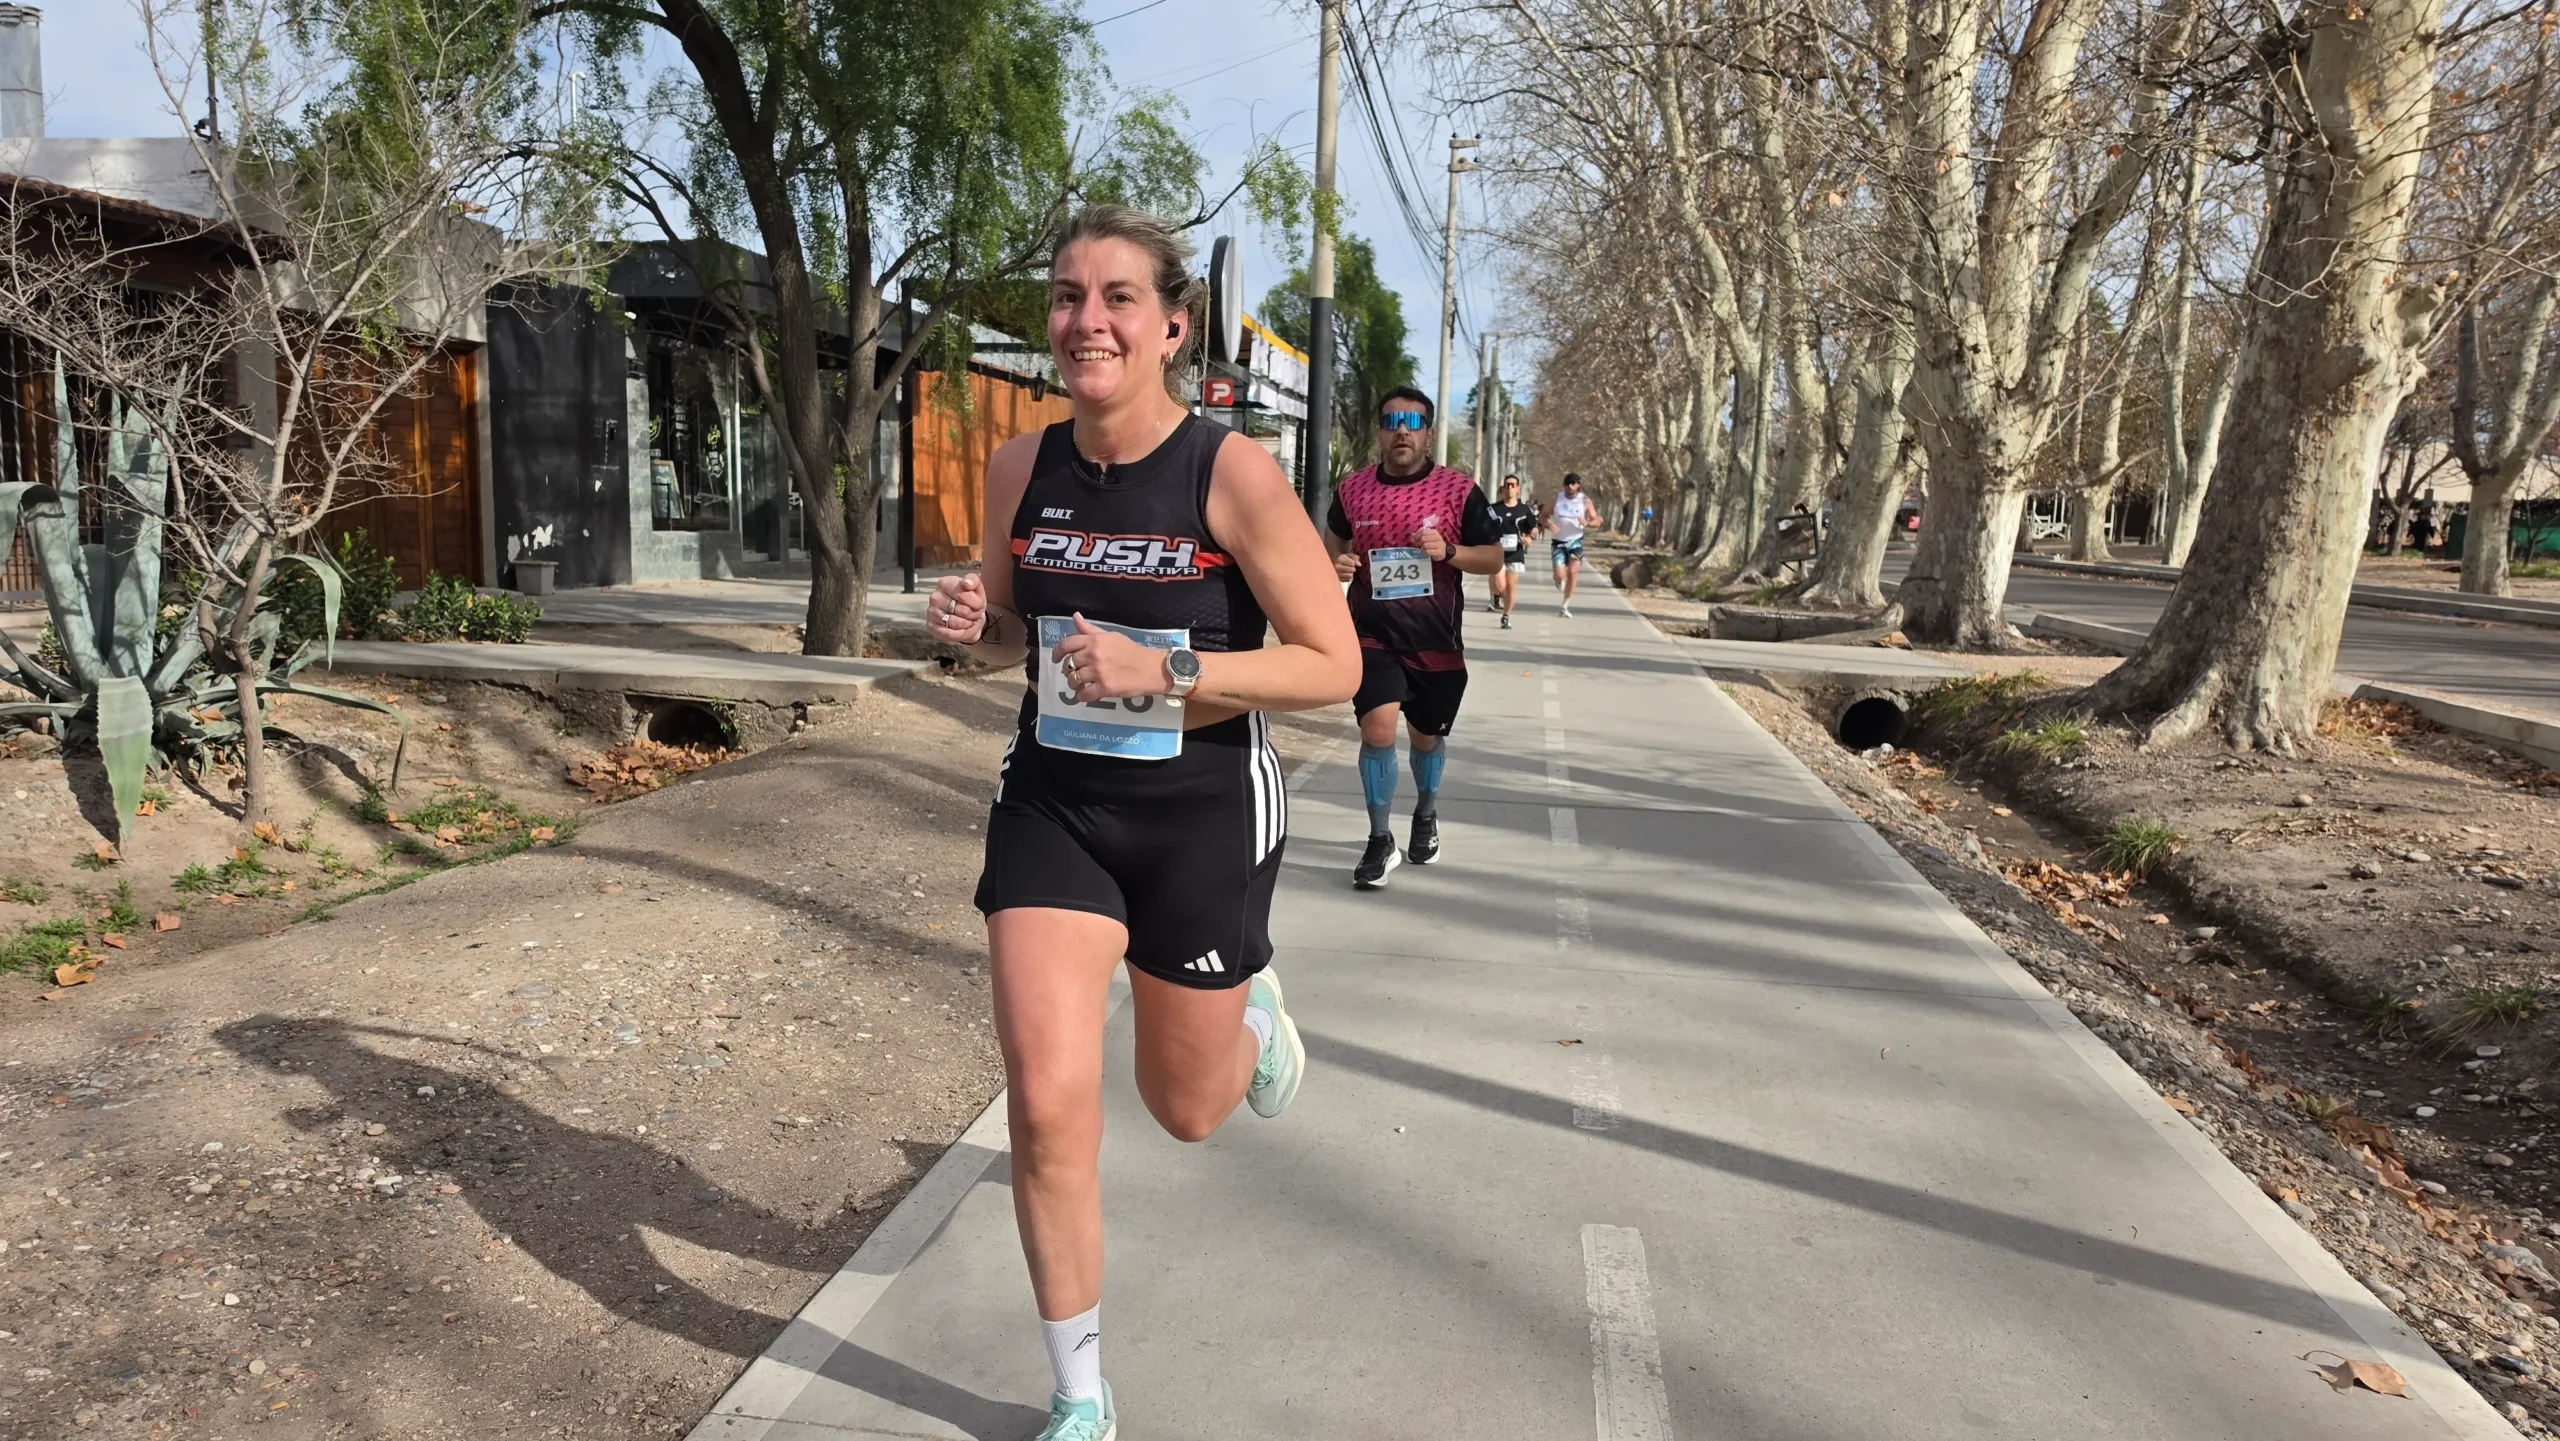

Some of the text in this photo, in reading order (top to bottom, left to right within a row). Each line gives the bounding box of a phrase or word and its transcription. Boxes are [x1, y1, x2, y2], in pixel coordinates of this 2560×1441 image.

[1026, 533, 1194, 567] PUSH
[1024, 556, 1198, 575] ACTITUD DEPORTIVA
[1380, 564, 1420, 582] 243
[1063, 730, 1140, 745] GIULIANA DA LOZZO
